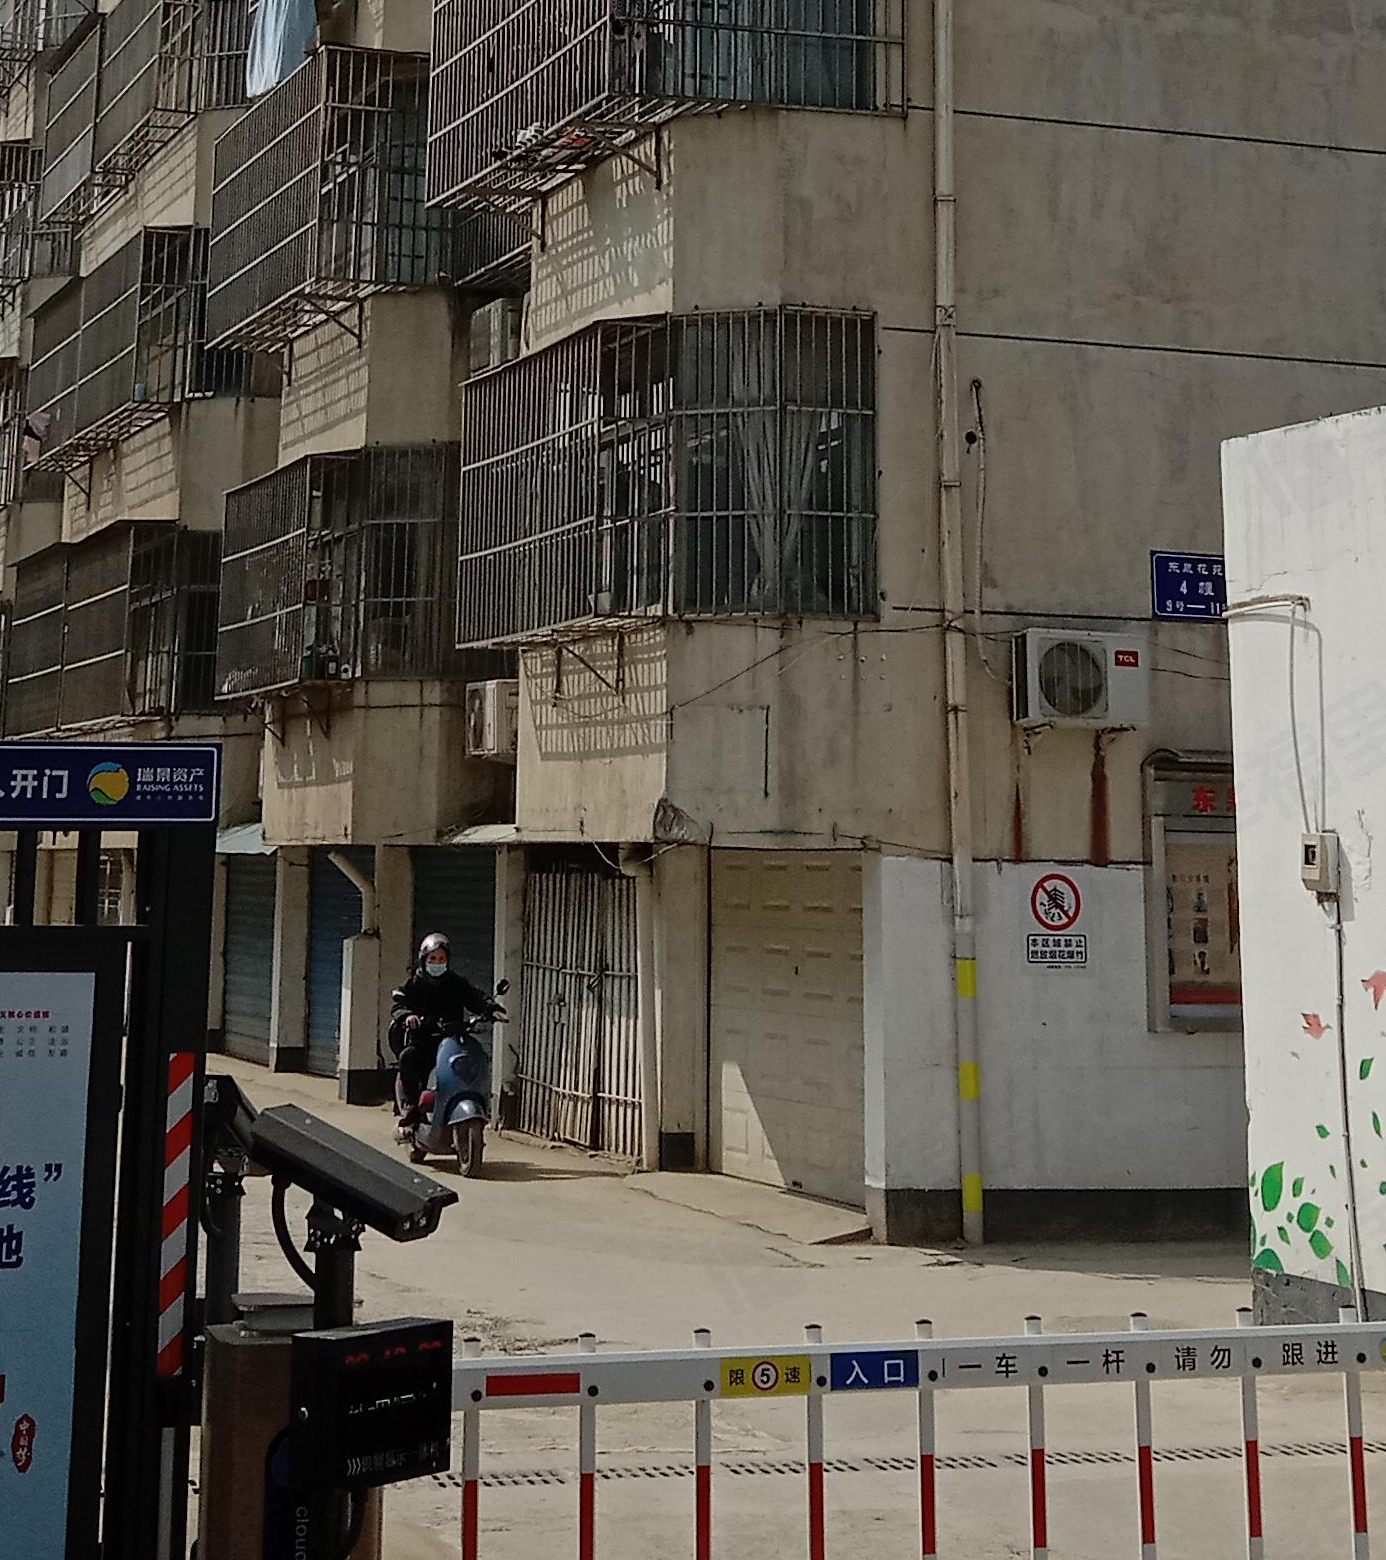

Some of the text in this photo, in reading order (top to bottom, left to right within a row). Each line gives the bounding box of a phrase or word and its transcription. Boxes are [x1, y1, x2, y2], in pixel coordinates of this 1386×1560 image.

[1179, 580, 1188, 595] 4
[1116, 653, 1136, 663] TCL
[136, 767, 205, 782] 瑞景资产
[136, 784, 205, 792] RAISING ASSETS
[957, 1339, 1339, 1378] 一车 一杆 请勿 跟进
[845, 1358, 906, 1385] 入口
